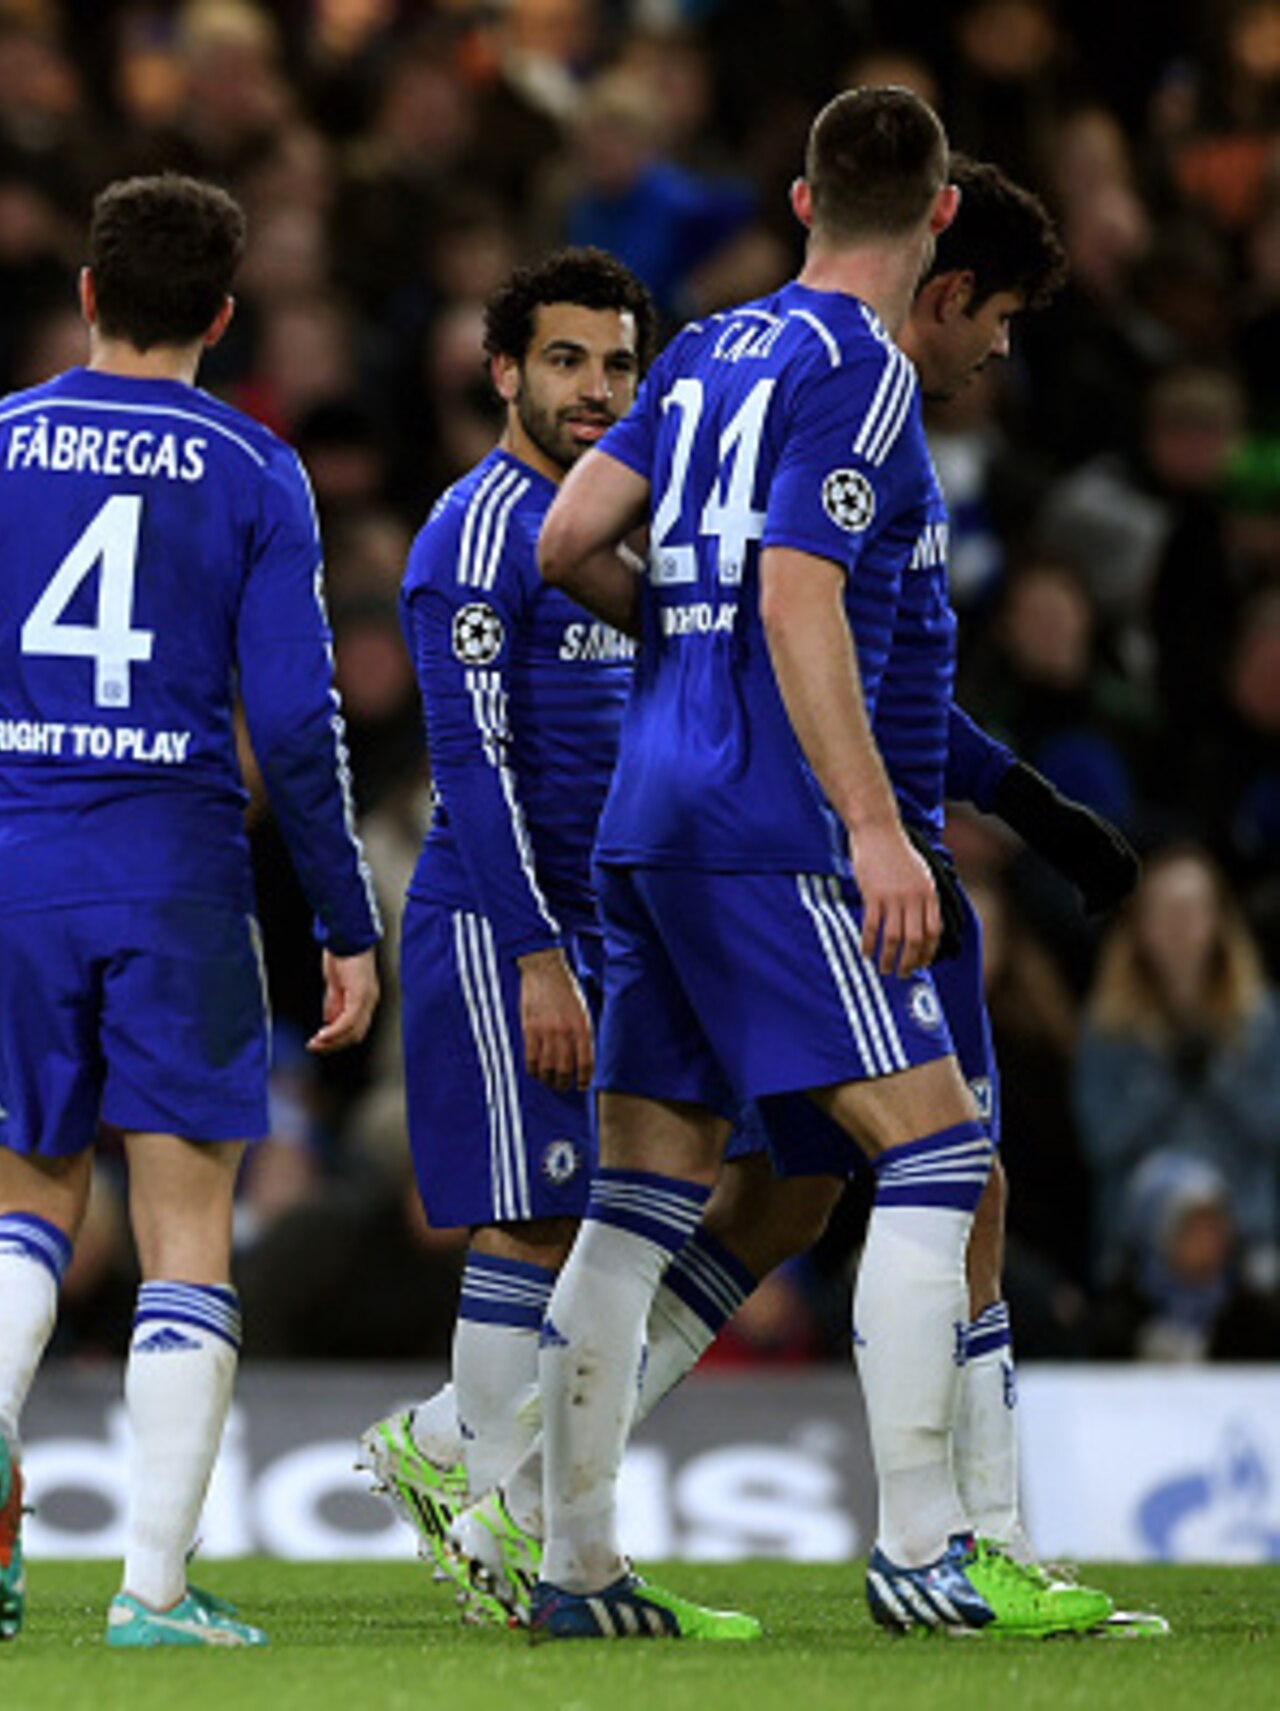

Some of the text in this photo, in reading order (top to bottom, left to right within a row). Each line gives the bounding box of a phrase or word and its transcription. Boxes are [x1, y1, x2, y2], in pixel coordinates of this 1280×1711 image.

[650, 378, 774, 585] 24
[21, 495, 154, 708] 4
[71, 723, 113, 758] TO
[114, 727, 191, 764] PLAY
